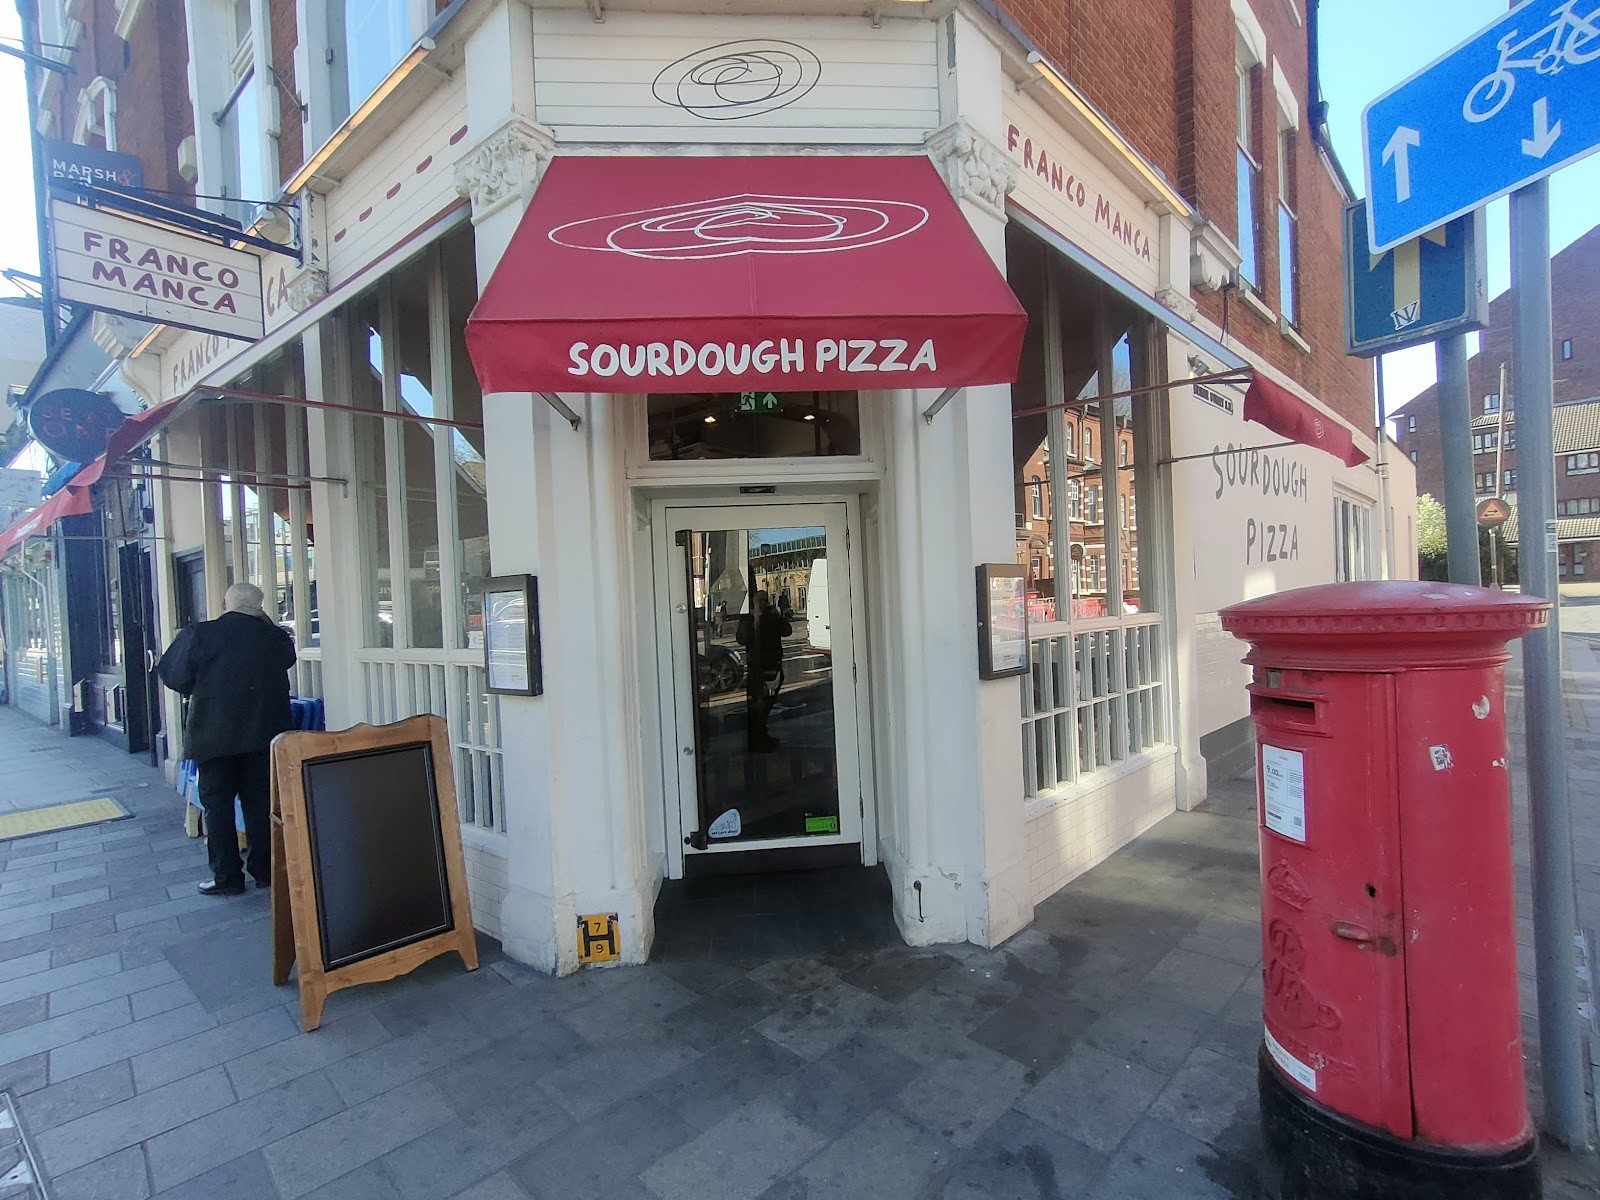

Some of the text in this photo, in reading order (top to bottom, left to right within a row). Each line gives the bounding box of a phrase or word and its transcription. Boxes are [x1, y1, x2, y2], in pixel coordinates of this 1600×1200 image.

[53, 159, 117, 182] MARSH
[1007, 124, 1151, 263] FRANCO MANCA
[83, 231, 239, 289] FRANCO
[92, 261, 237, 314] MANCA
[173, 334, 220, 394] FRANCO
[567, 337, 937, 377] SOURDOUGH PIZZA
[1212, 442, 1308, 504] SOURDOUGH
[1245, 517, 1300, 566] PIZZA
[593, 922, 601, 932] 7
[595, 943, 604, 954] 9
